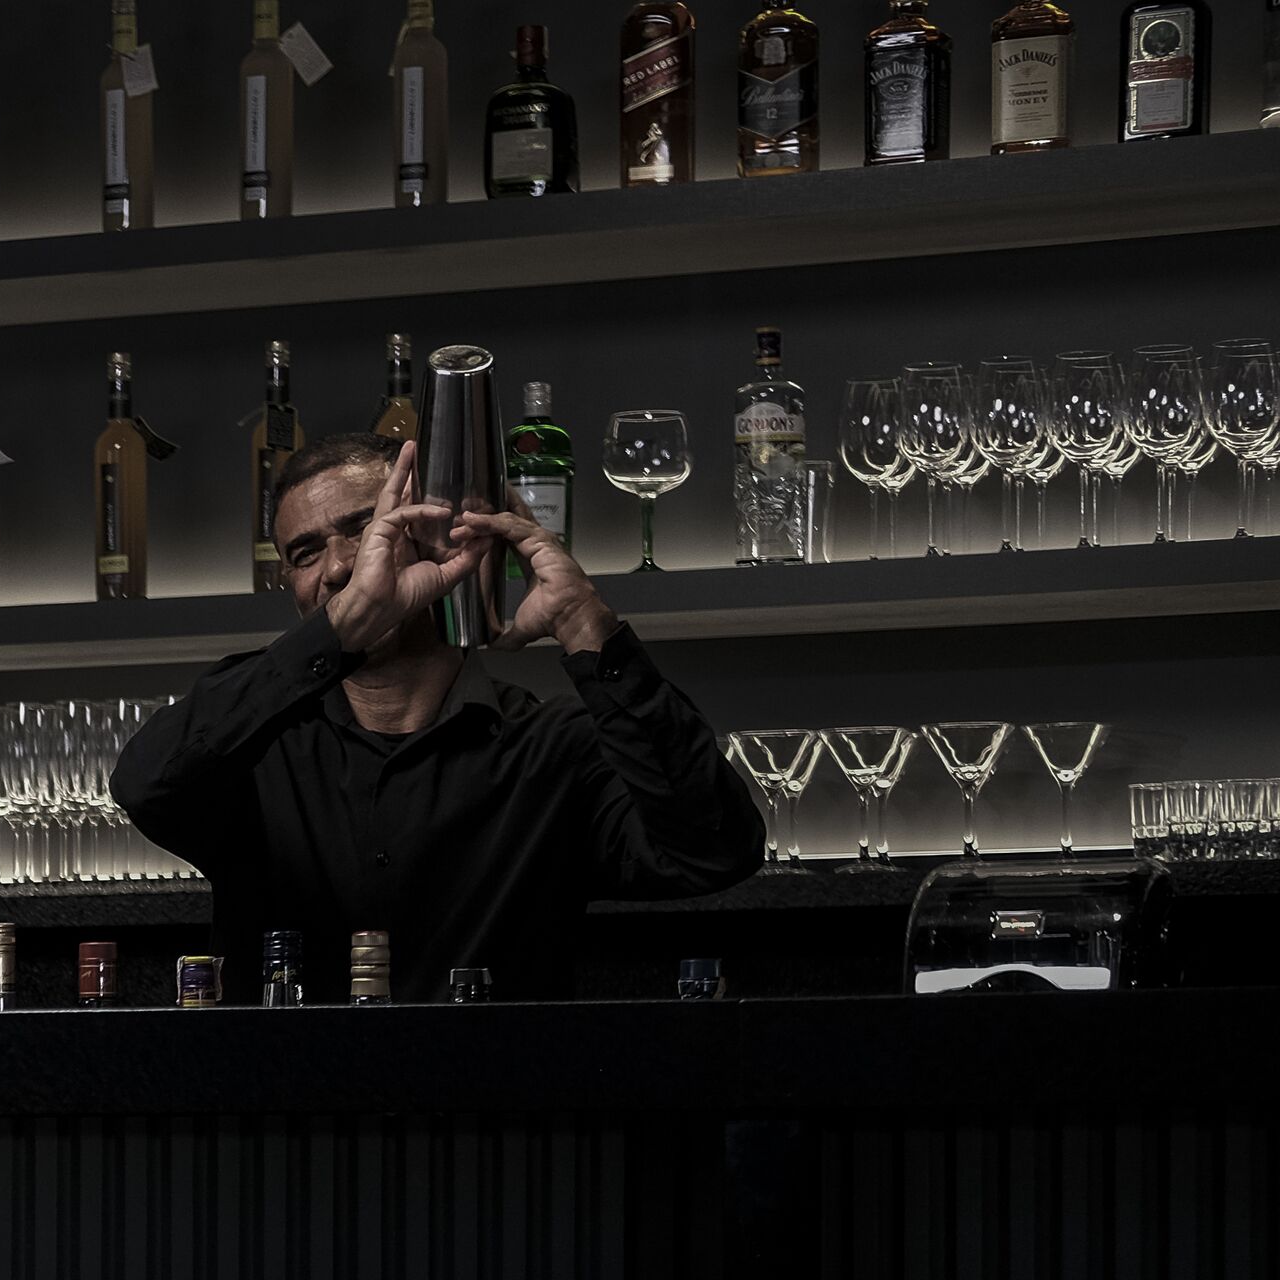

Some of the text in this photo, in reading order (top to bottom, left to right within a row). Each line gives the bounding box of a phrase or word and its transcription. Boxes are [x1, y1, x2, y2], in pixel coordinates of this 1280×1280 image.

[622, 55, 680, 87] RED LABEL
[999, 54, 1021, 72] JACK
[870, 66, 893, 86] JACK
[766, 107, 778, 119] 12
